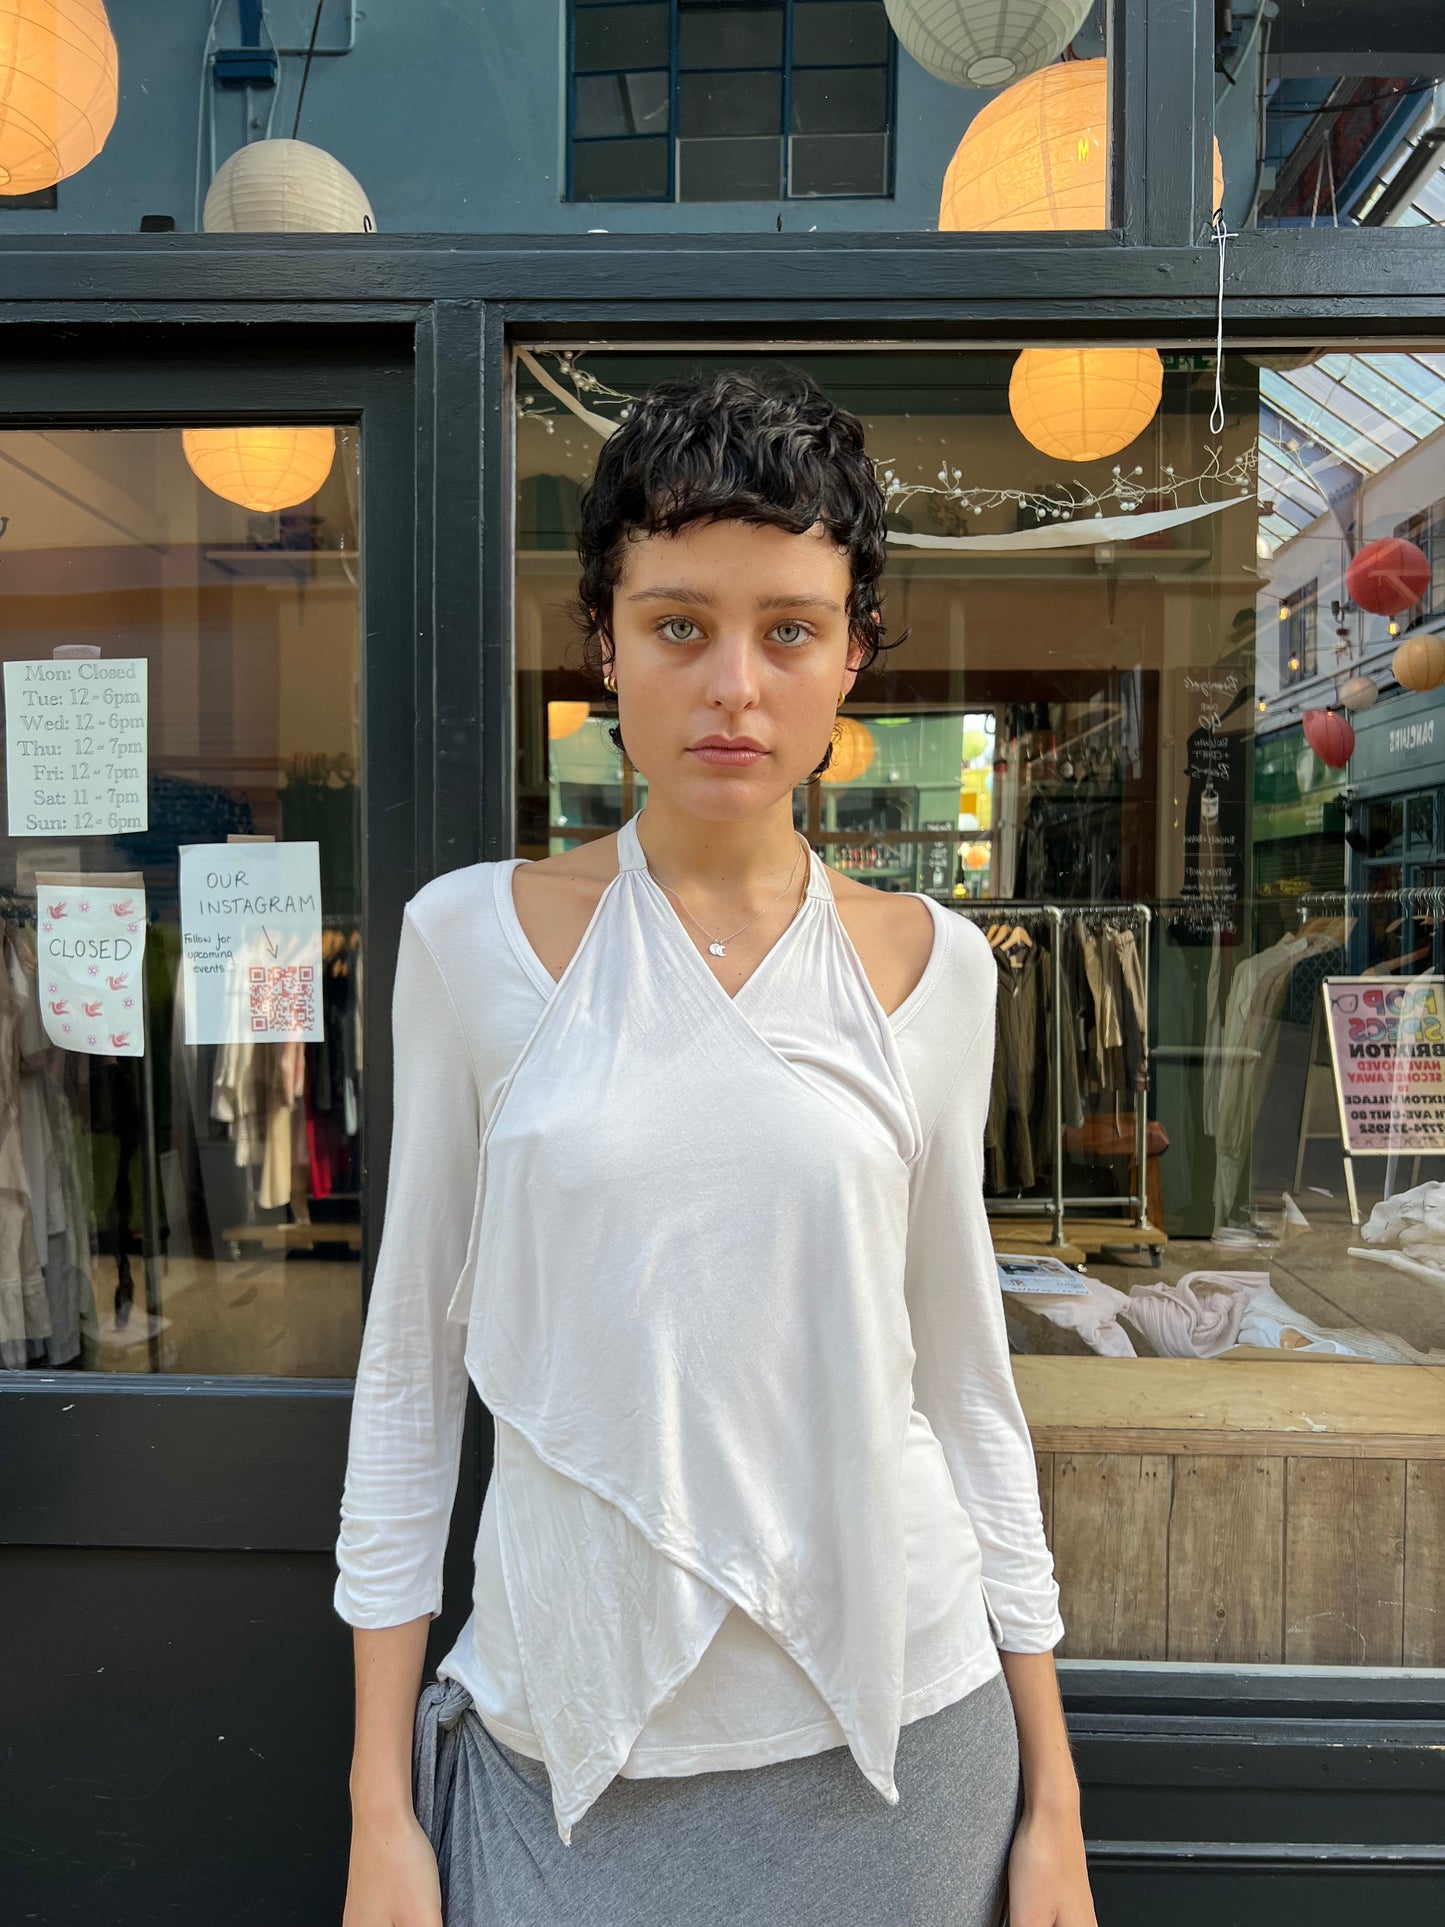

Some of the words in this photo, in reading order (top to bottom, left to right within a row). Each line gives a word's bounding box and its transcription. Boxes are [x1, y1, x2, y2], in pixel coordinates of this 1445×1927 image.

[25, 664, 71, 681] Mon:
[78, 663, 137, 680] Closed
[22, 690, 63, 706] Tue:
[19, 715, 69, 730] Wed:
[16, 740, 61, 756] Thu:
[33, 765, 64, 781] Fri:
[33, 789, 66, 805] Sat:
[26, 814, 67, 830] Sun:
[206, 870, 249, 889] OUR
[199, 894, 316, 915] INSTAGRAM
[49, 938, 133, 961] CLOSED
[184, 932, 211, 944] Follow
[215, 932, 232, 951] for
[187, 950, 236, 966] upcoming
